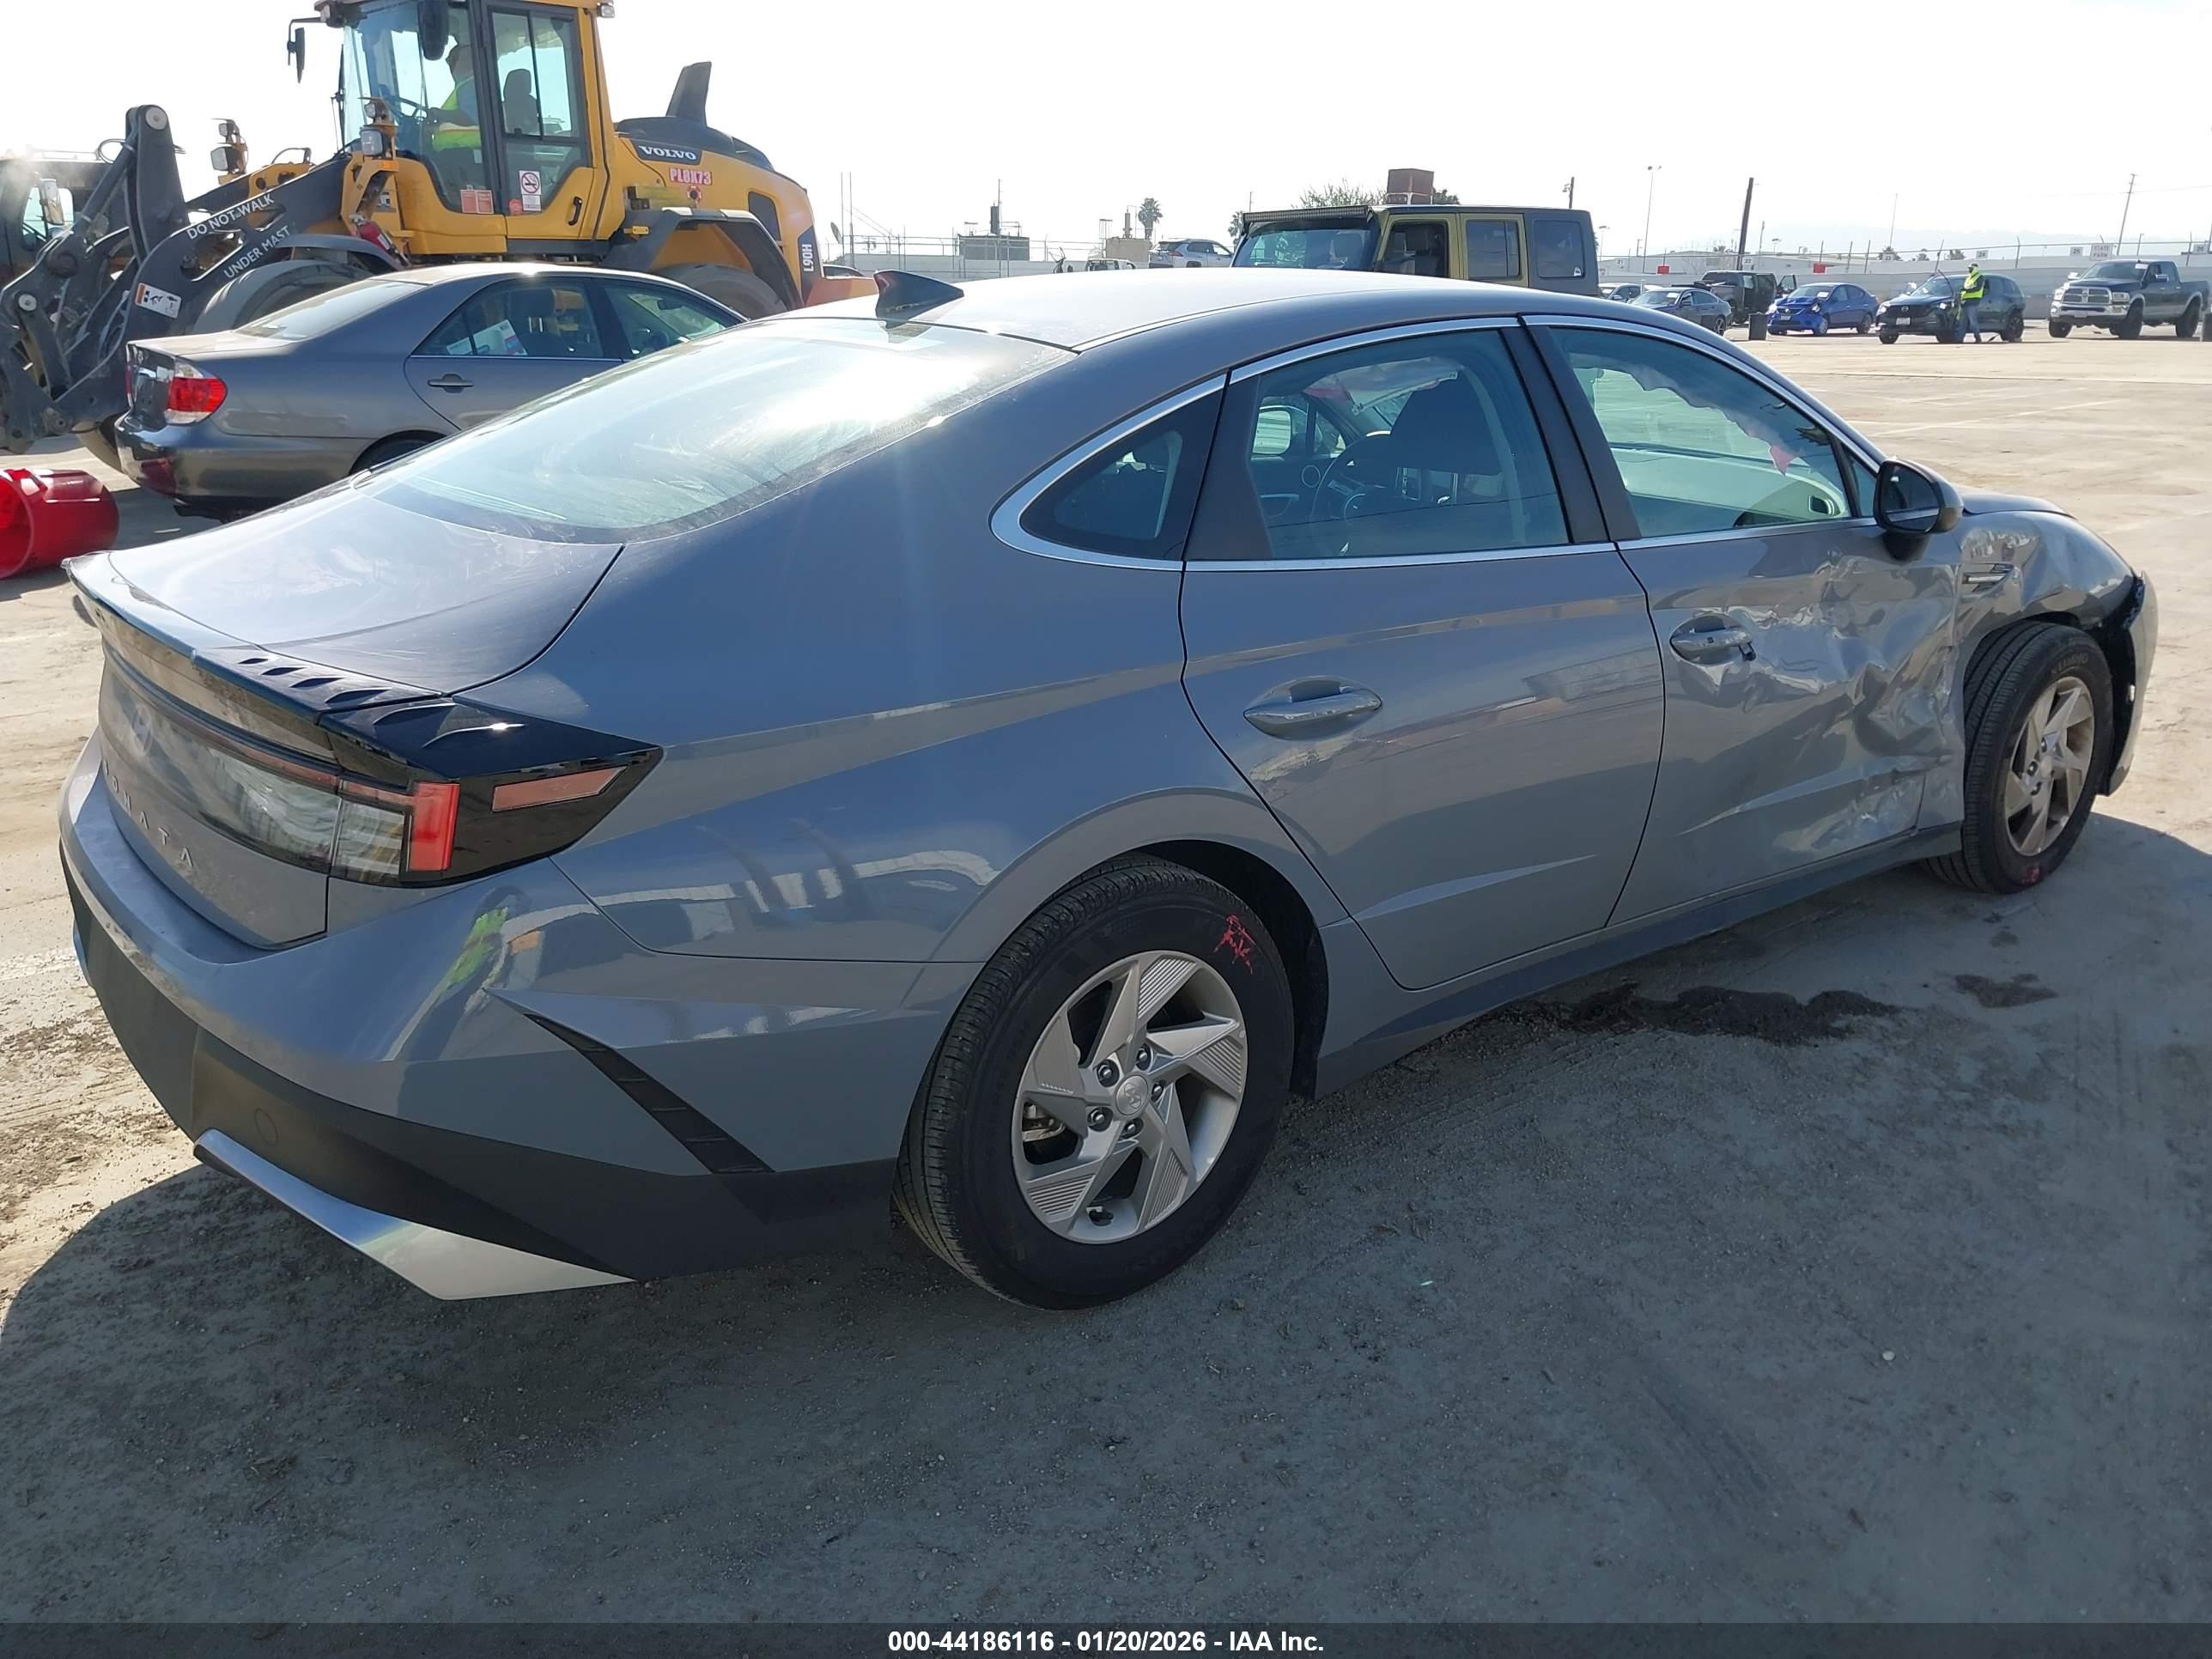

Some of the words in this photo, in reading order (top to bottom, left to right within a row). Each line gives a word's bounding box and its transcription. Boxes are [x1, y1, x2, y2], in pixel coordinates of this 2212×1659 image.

[638, 145, 697, 161] VOLVO
[186, 224, 208, 240] DO
[208, 210, 238, 229] NOT
[237, 193, 275, 216] WALK
[223, 247, 264, 278] UNDER
[261, 225, 291, 252] MAST
[801, 244, 814, 272] L90H
